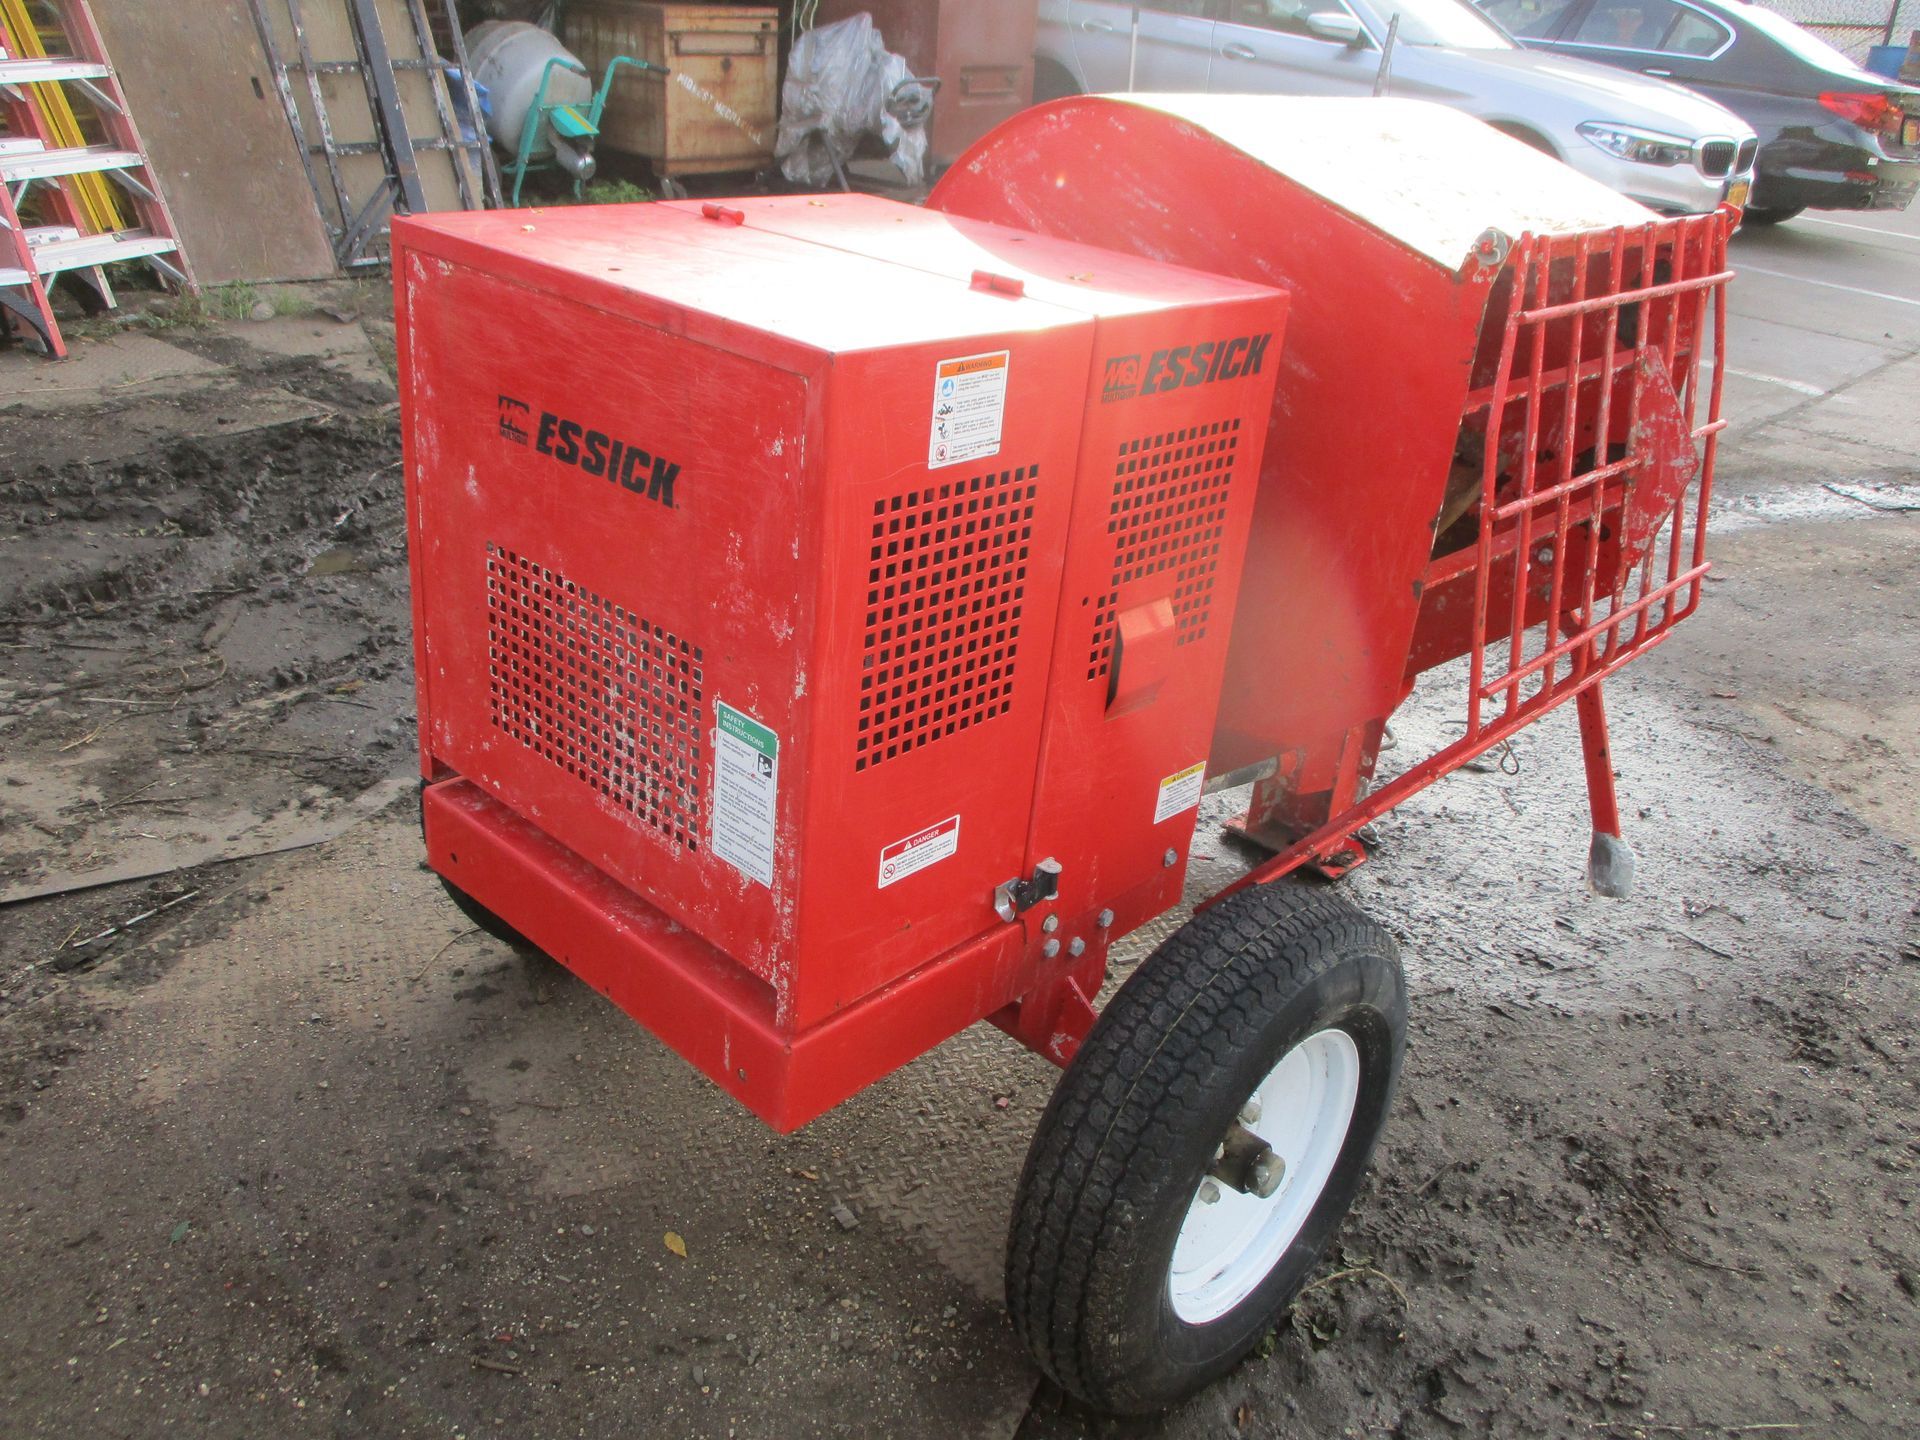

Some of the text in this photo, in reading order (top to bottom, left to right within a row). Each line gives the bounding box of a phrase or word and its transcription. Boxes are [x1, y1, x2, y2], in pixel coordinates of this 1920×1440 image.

[965, 360, 992, 371] WARNING
[1139, 333, 1273, 396] ESSICK
[536, 411, 681, 509] ESSICK
[723, 711, 745, 728] SAFETY
[722, 720, 765, 749] INSTRUCTIONS
[913, 829, 940, 846] DANGER
